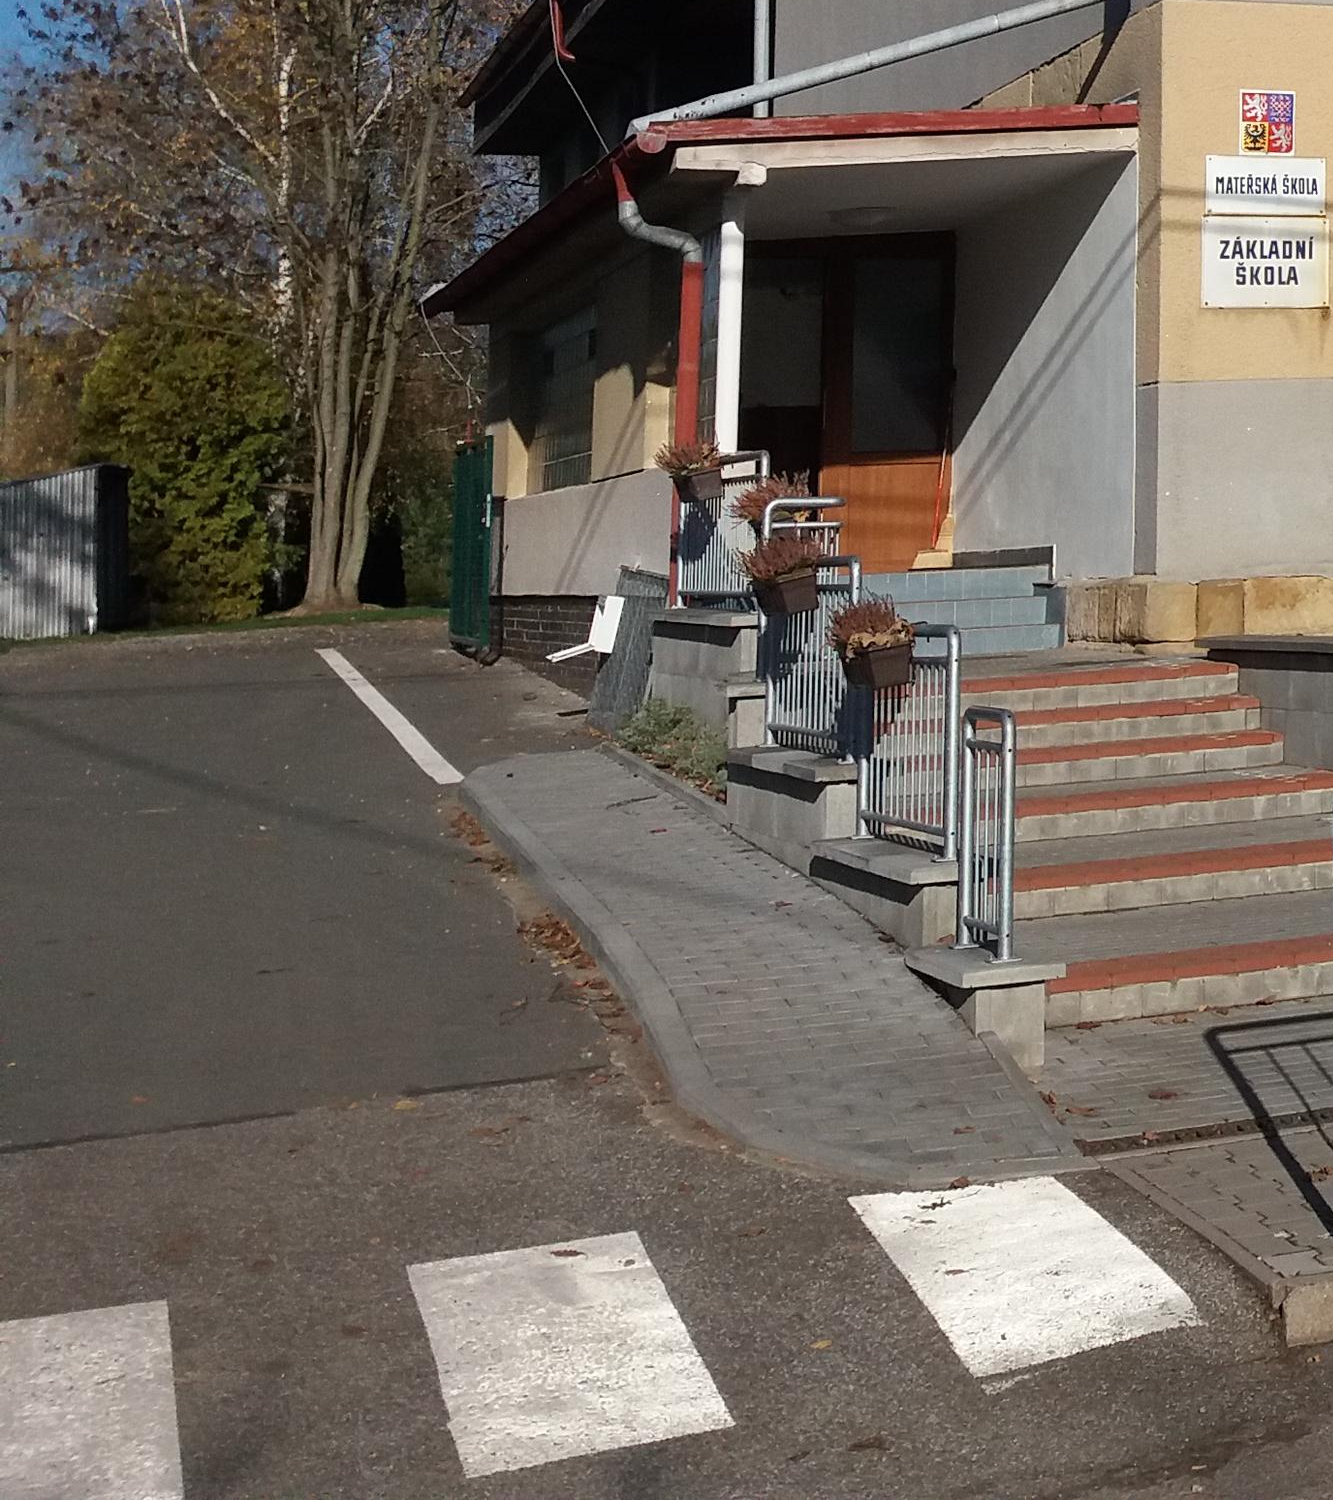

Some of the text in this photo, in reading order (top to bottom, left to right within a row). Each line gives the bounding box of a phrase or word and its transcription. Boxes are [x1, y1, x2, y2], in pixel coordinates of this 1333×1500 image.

[1214, 173, 1319, 196] MATEŘSKÁ ŠKOLA
[1219, 236, 1315, 260] ZÁKLADNÍ
[1235, 262, 1299, 286] ŠKOLA
